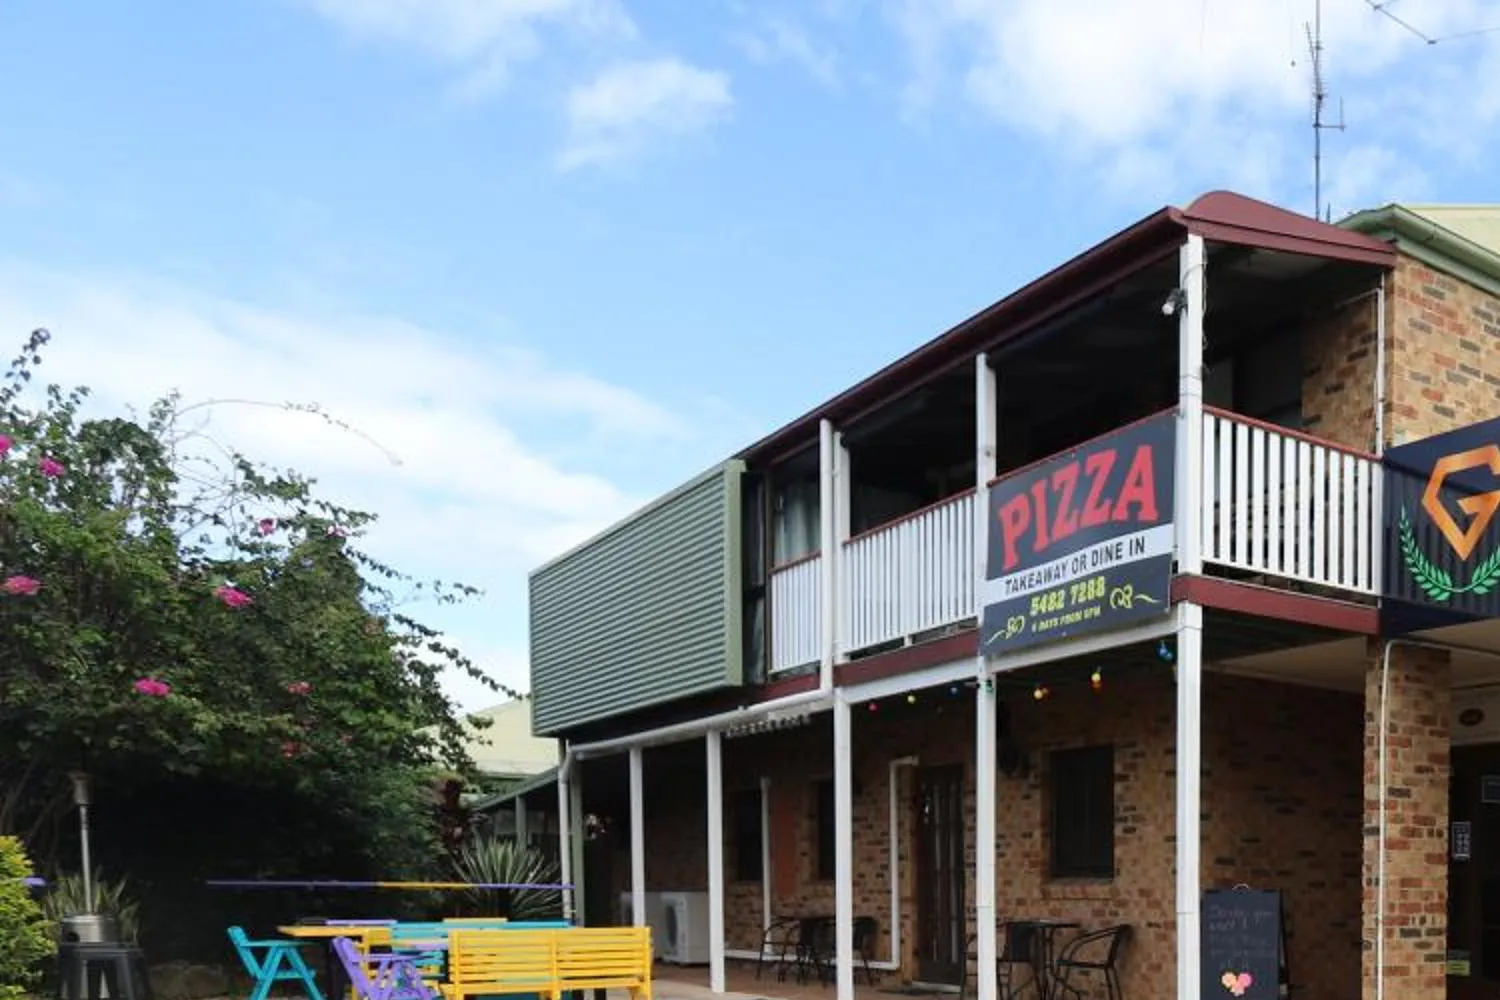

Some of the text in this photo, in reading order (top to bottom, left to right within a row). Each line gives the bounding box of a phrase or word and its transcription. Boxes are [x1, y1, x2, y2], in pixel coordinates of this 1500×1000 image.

[998, 445, 1159, 570] PIZZA
[1005, 536, 1146, 594] TAKEAWAY OR DINE IN
[1031, 589, 1065, 616] 5482
